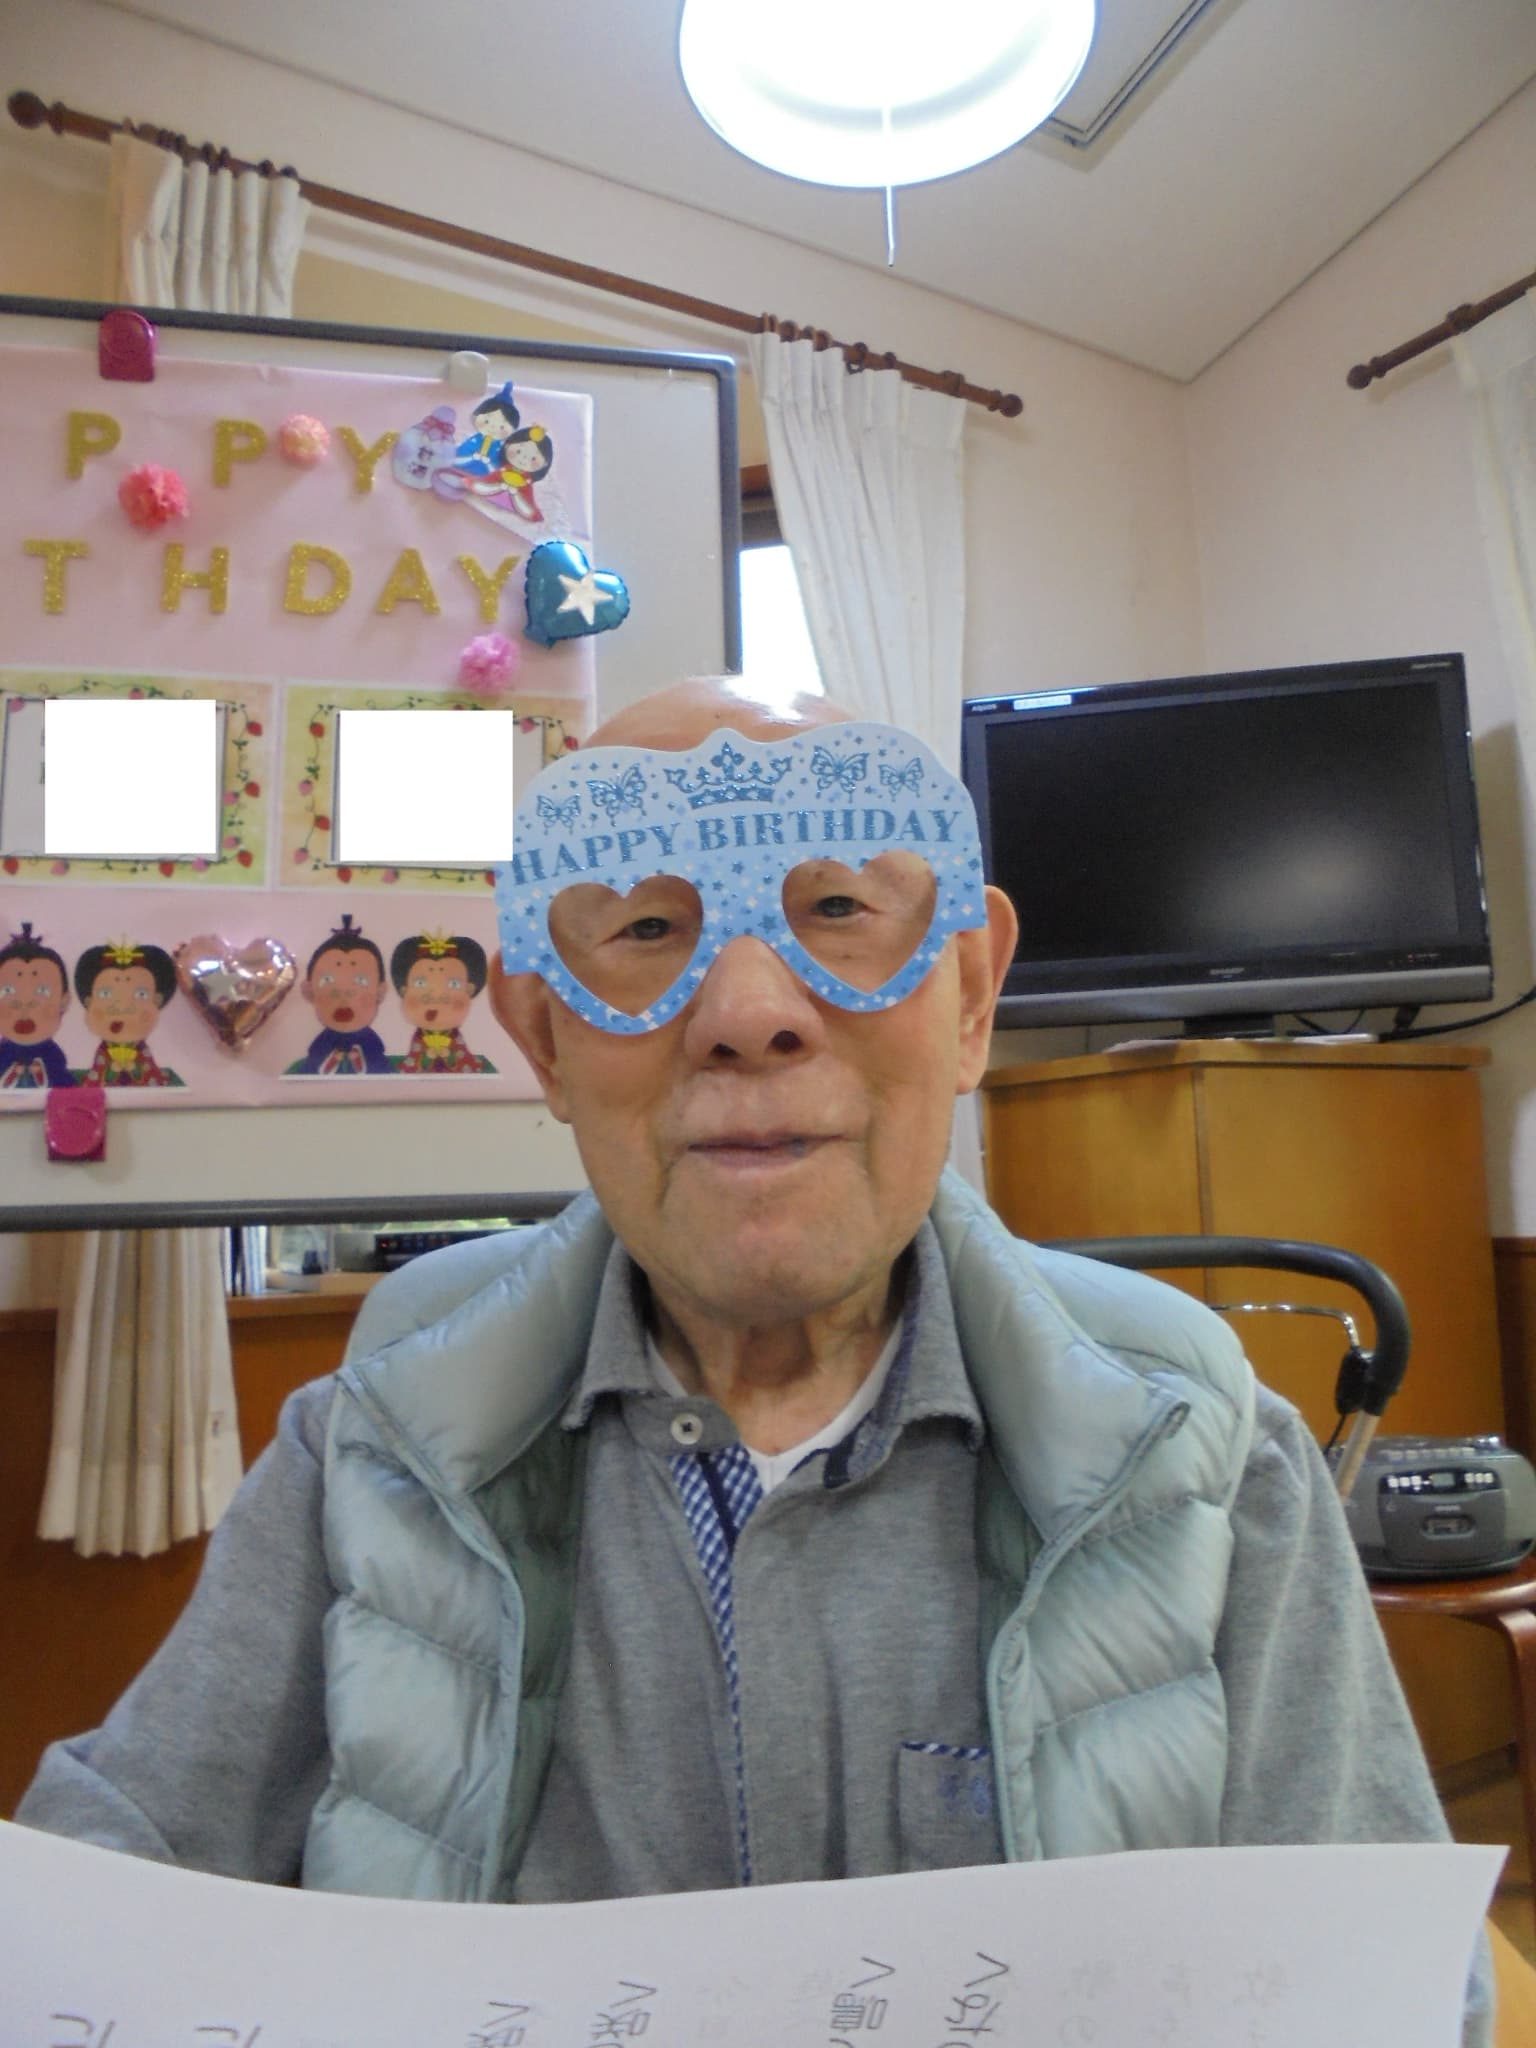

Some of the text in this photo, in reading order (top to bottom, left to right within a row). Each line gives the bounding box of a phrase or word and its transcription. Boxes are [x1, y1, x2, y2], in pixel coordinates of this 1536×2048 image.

[23, 539, 519, 623] THDAY
[512, 808, 961, 886] HAPPY BIRTHDAY
[590, 1980, 658, 2048] 咲く
[829, 1956, 897, 2048] 鳴く
[936, 1951, 1010, 2048] なく
